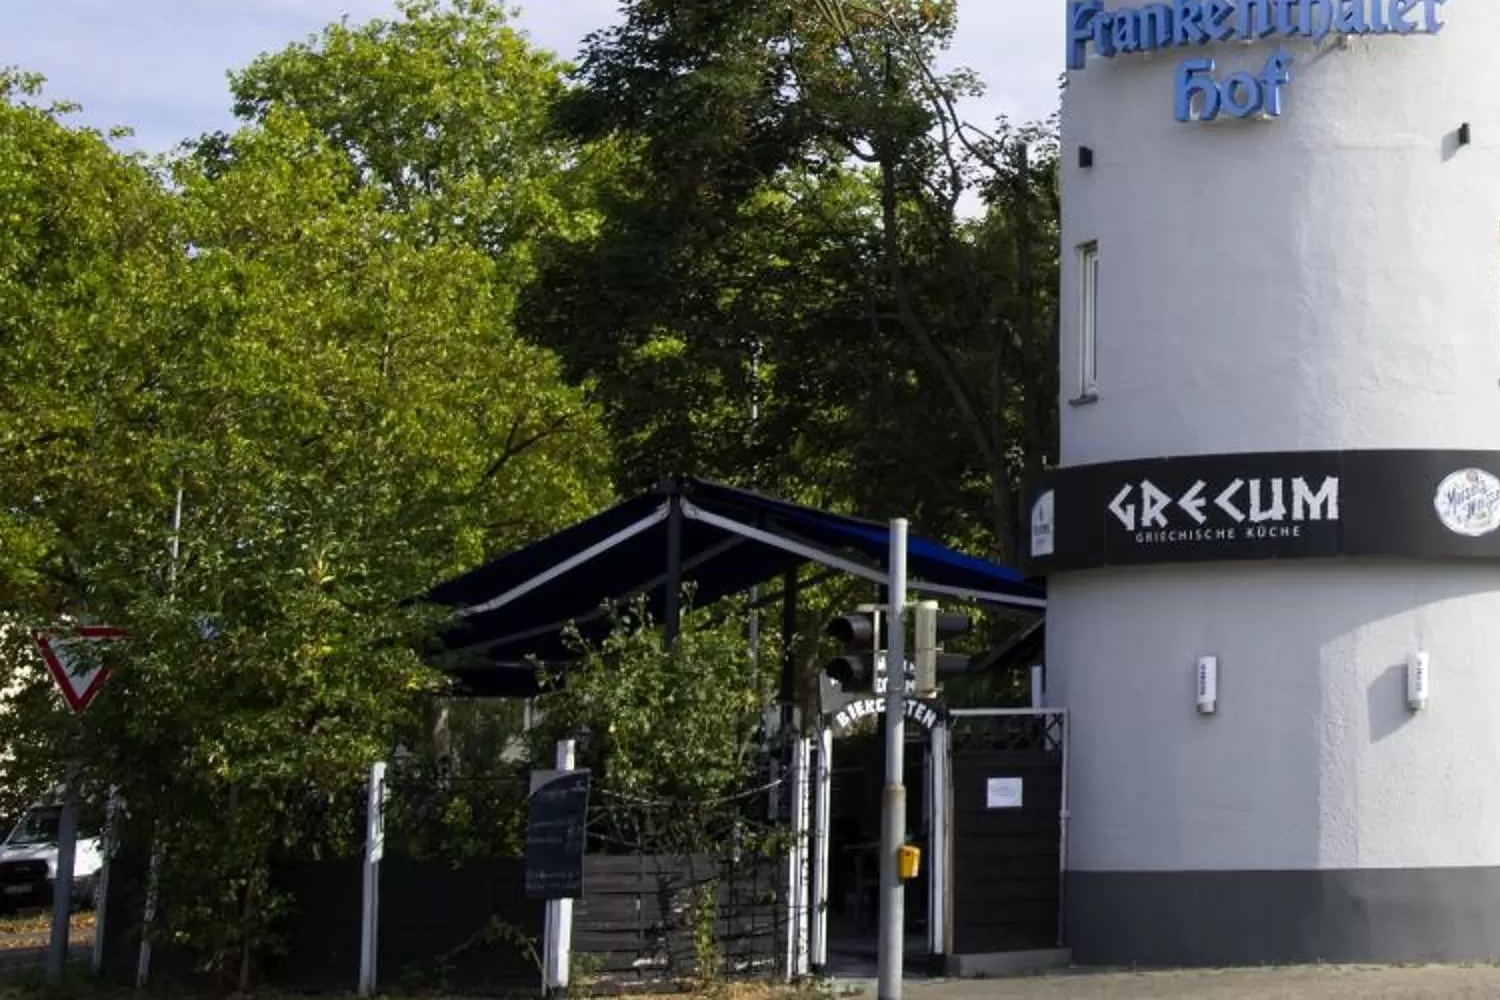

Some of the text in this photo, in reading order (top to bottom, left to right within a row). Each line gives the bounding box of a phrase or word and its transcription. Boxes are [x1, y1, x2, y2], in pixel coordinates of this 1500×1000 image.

[1107, 475, 1340, 531] GRECUM
[1135, 527, 1236, 544] GRIECHISCHE
[836, 698, 937, 729] BIERGTEN
